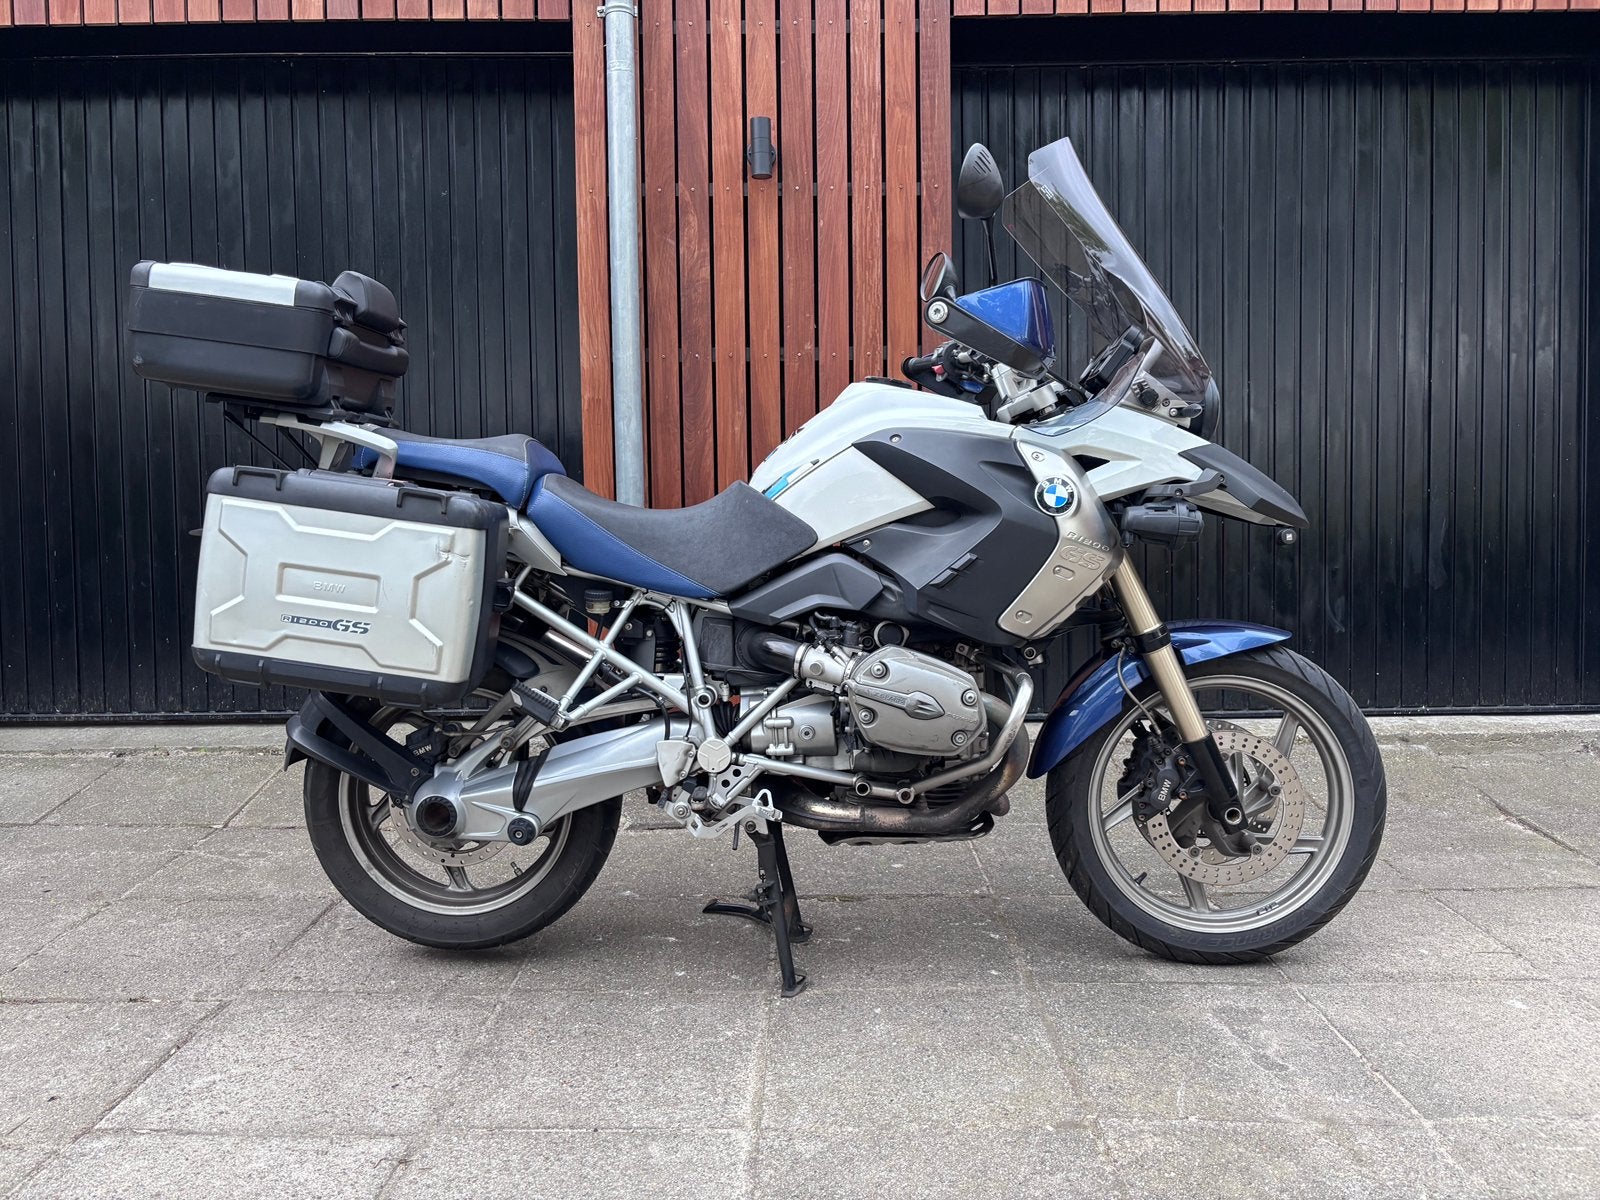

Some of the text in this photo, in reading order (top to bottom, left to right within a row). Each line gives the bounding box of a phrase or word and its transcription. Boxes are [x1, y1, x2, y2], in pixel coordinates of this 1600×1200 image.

[1041, 477, 1074, 493] BMW
[1066, 531, 1110, 552] R1200
[1060, 545, 1106, 571] GS
[313, 580, 346, 594] BMW
[412, 743, 432, 756] BMW
[1157, 778, 1172, 802] BMW
